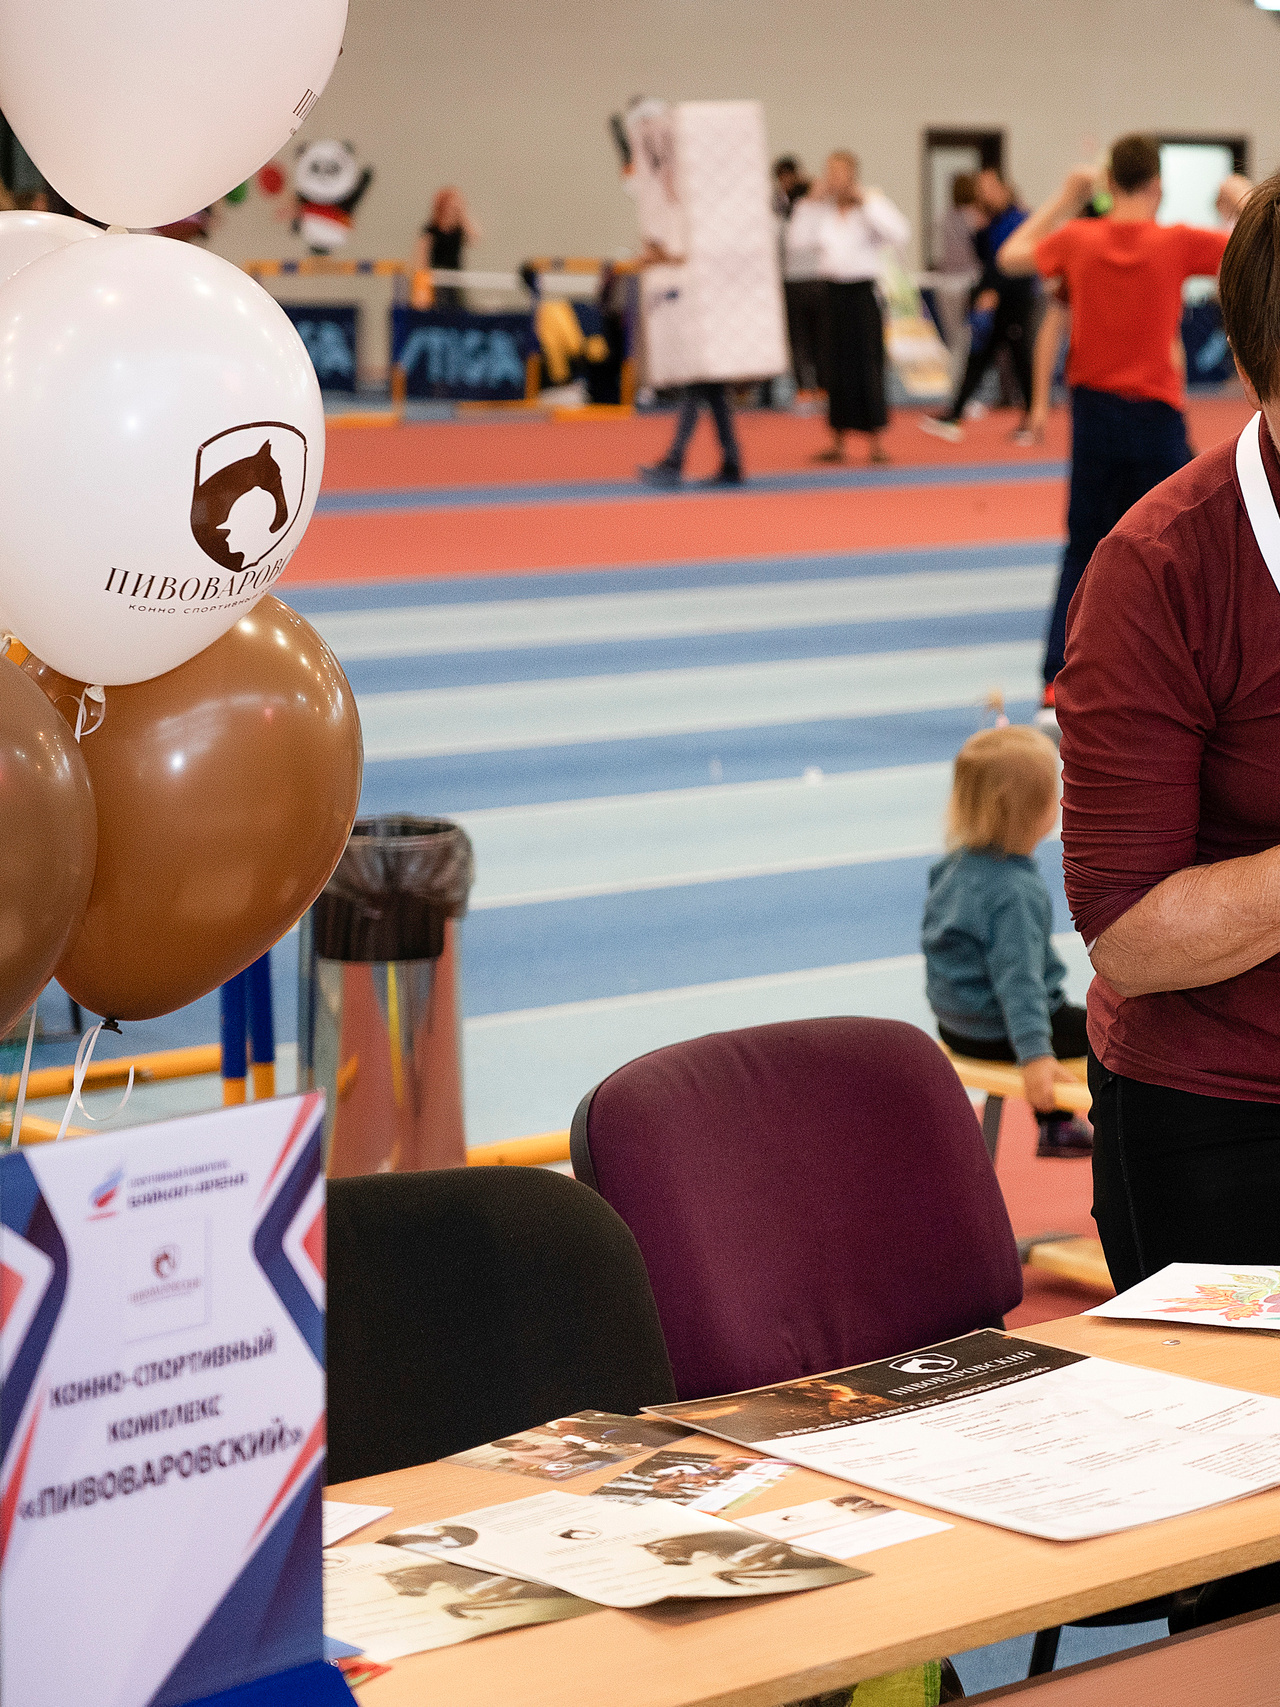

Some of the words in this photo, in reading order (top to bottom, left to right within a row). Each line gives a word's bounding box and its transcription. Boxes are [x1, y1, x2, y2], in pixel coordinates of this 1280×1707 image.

[128, 604, 176, 614] КОННО
[50, 1327, 277, 1408] КОННО-СПОРТИВНЫЙ
[886, 1350, 1038, 1396] ПИВОВАРОВСКИЙ
[106, 1394, 222, 1443] КОМПЛЕКС
[917, 1397, 946, 1407] КСК
[17, 1417, 304, 1520] «ПИВОВАРОВСКИЙ»
